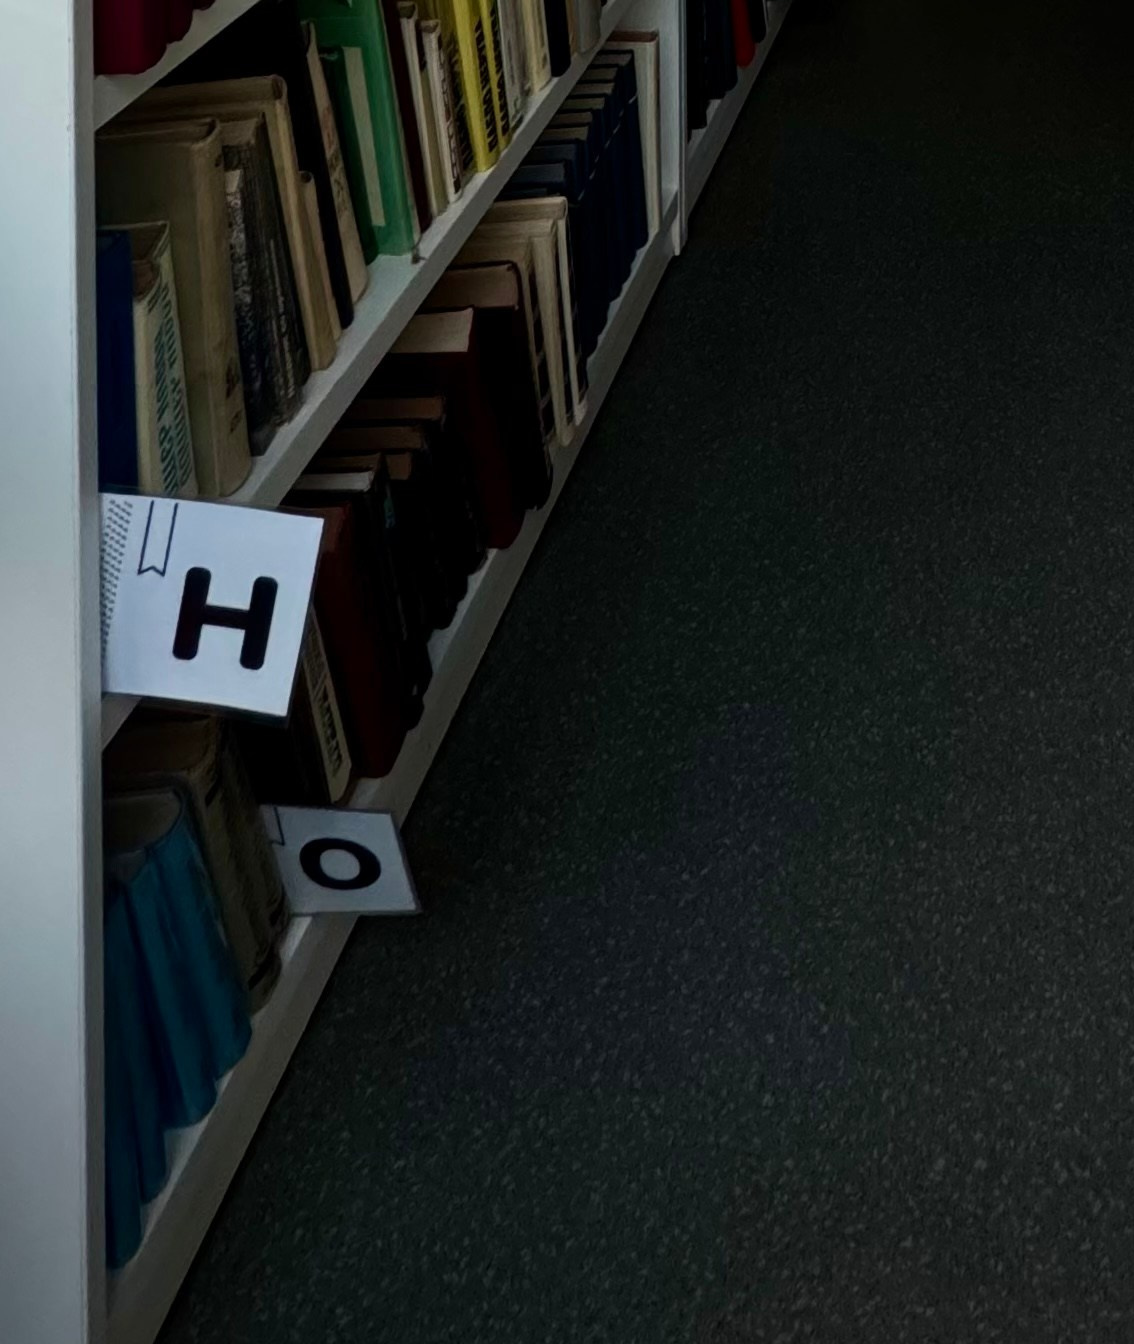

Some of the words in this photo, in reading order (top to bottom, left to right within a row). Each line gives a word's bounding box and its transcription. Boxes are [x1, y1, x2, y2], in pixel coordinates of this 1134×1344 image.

[474, 16, 491, 88] НЕРУДА
[484, 88, 500, 152] ПАБЛО
[172, 567, 278, 670] Н
[299, 837, 381, 890] О
